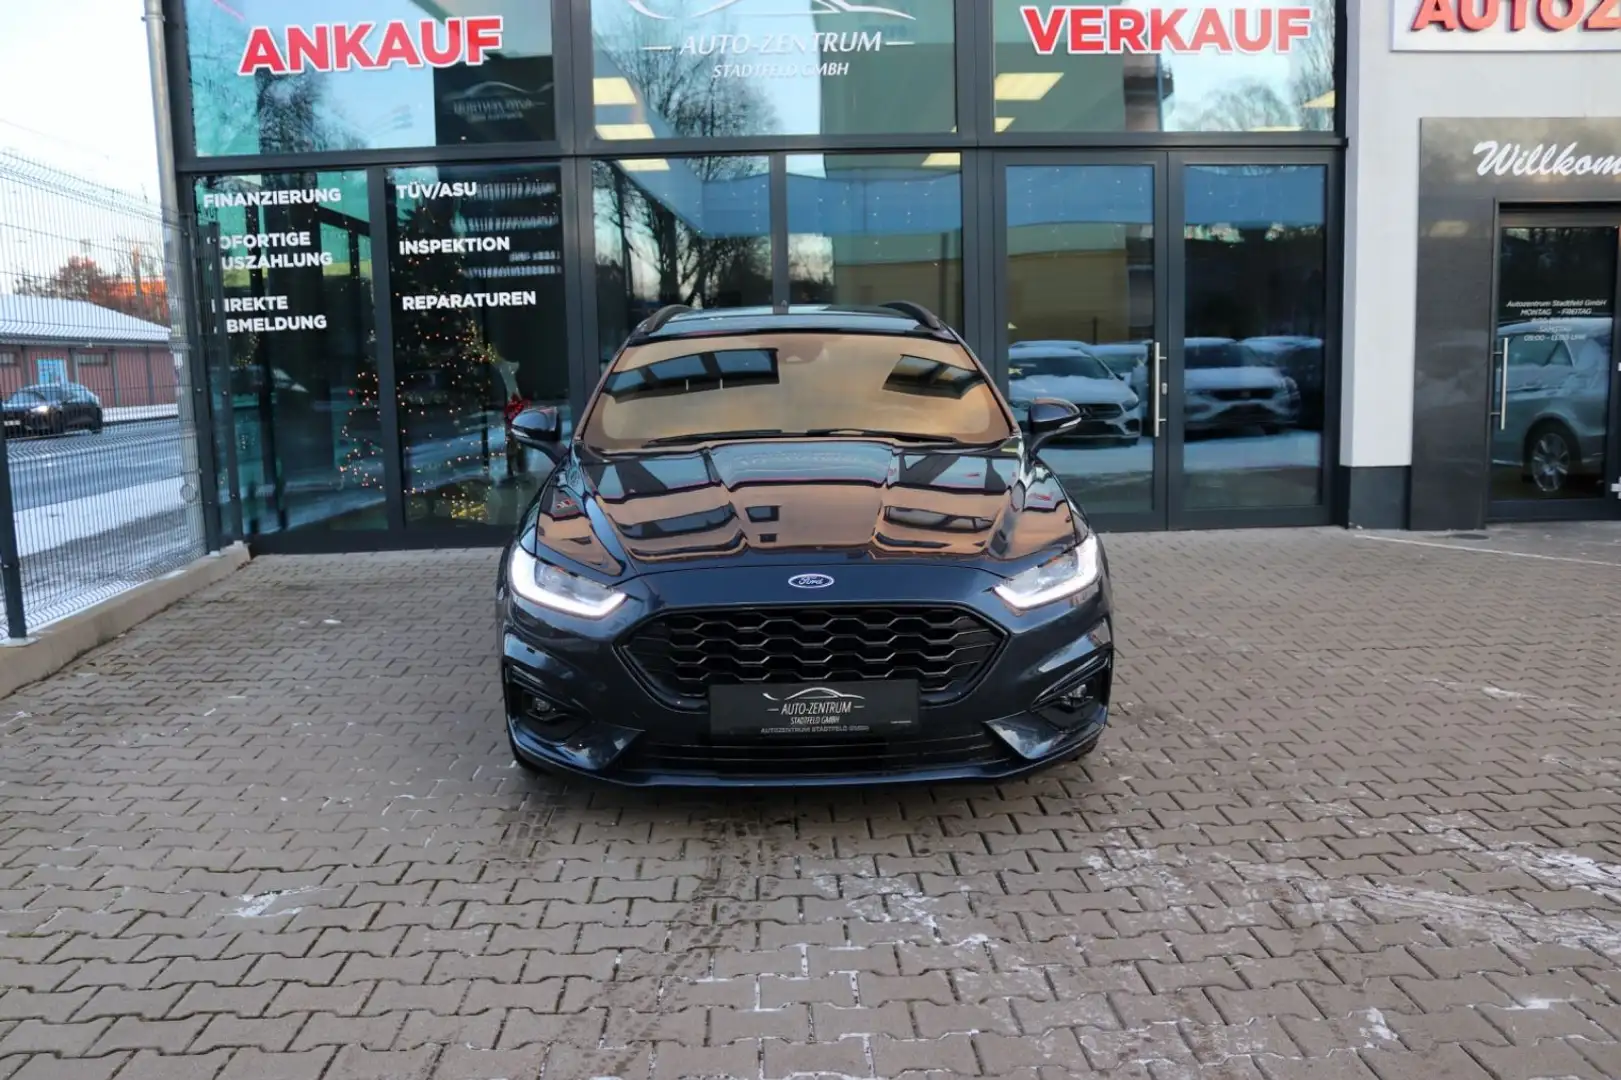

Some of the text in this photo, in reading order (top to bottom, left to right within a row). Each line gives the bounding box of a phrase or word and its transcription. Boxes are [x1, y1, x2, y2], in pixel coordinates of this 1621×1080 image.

[1020, 6, 1311, 55] VERKAUF
[238, 15, 503, 76] ANKAUF
[679, 31, 882, 55] AUTO-ZENTRUM
[712, 62, 849, 79] STADTFELD GMBH
[203, 188, 342, 208] FINANZIERUNG
[396, 182, 477, 199] TÜV/ASU
[399, 236, 511, 255] INSPEKTION
[209, 252, 333, 270] USZAHLUNG
[212, 296, 289, 313] IREKTE
[402, 290, 537, 311] REPARATUREN
[1520, 308, 1552, 316] MONTAG
[214, 315, 327, 334] BMELDUNG
[798, 575, 824, 585] Ford
[781, 701, 852, 715] AUTO-ZENTRUM
[790, 716, 820, 725] STADTFELD
